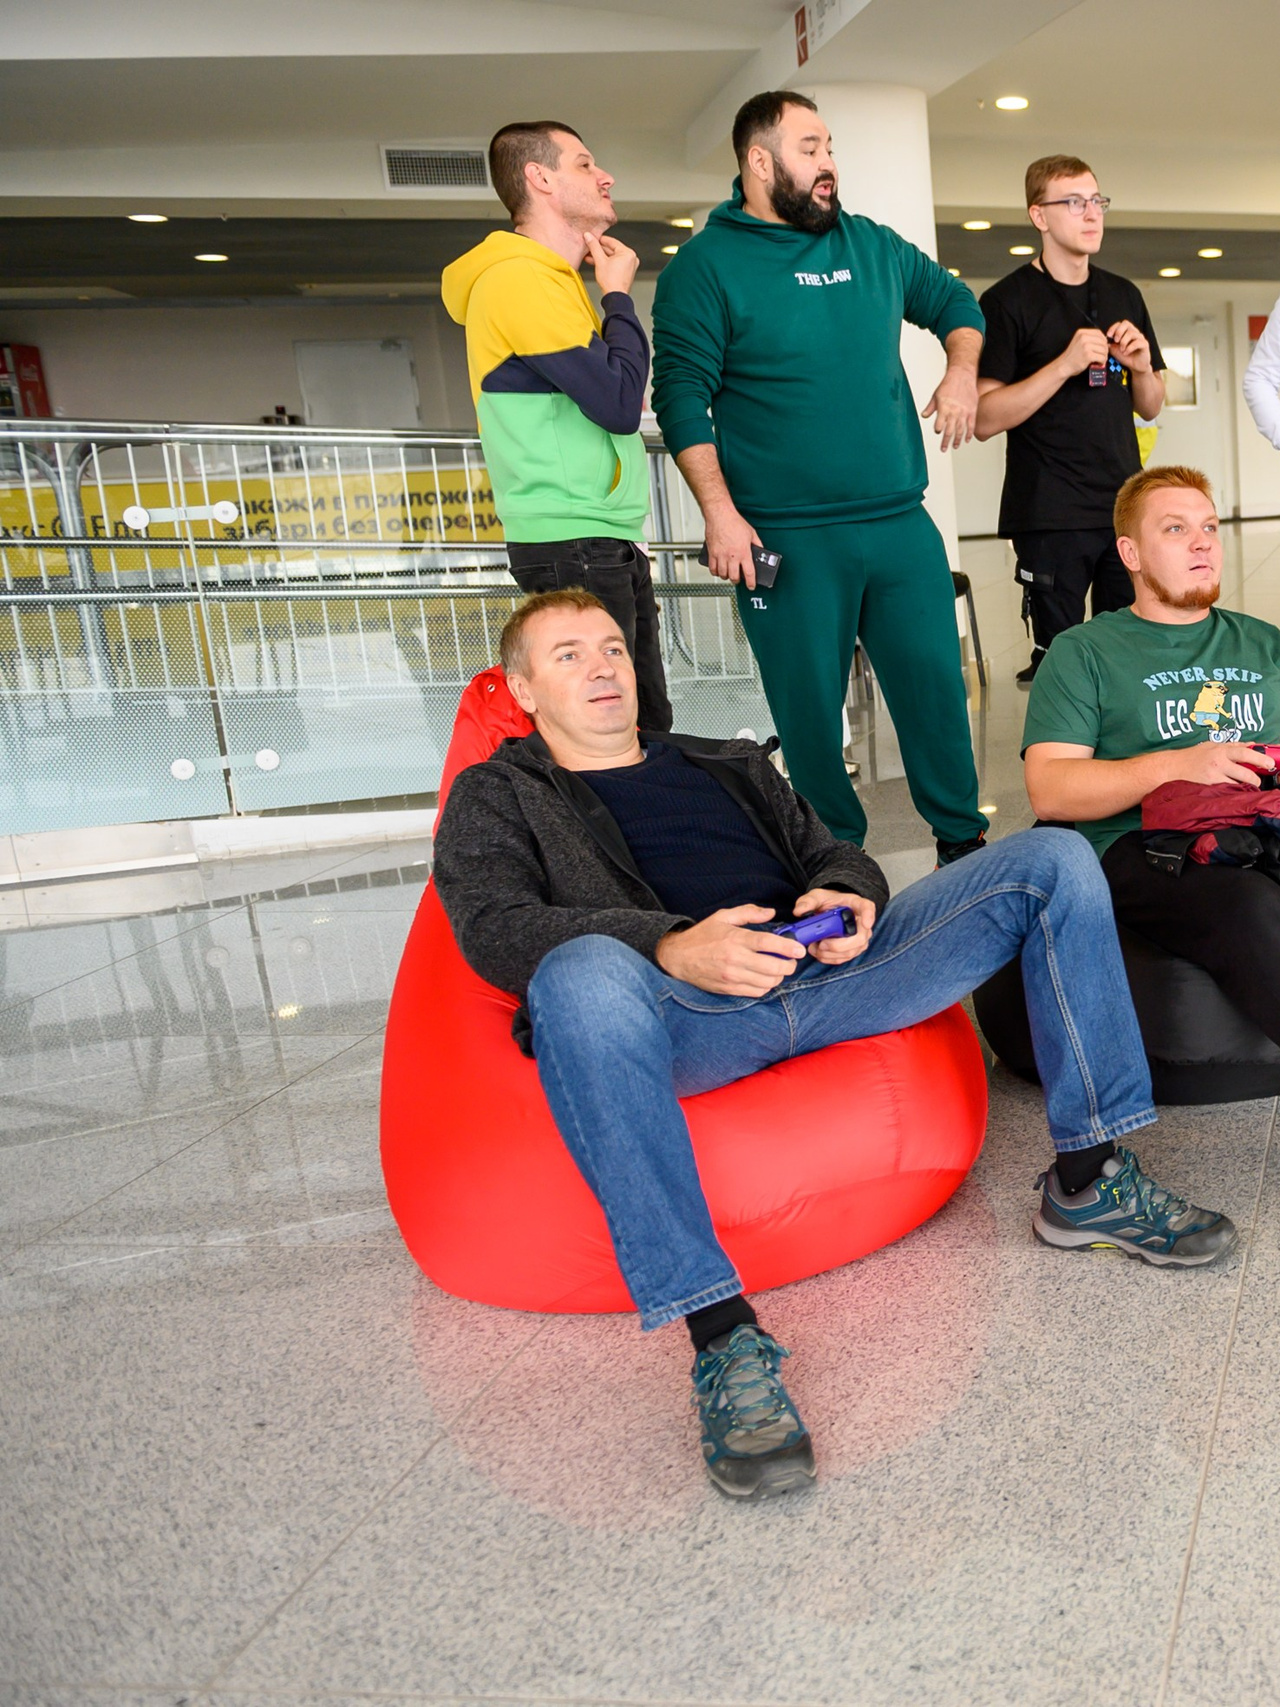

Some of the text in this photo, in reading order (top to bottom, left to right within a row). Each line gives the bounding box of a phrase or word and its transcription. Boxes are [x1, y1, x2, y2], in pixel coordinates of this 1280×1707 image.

[794, 269, 852, 286] THE LAW
[234, 495, 327, 517] акажи
[222, 512, 504, 541] забери без очереди
[750, 597, 767, 610] TL
[1143, 666, 1263, 692] NEVER SKIP
[1156, 692, 1265, 740] LEG DAY
